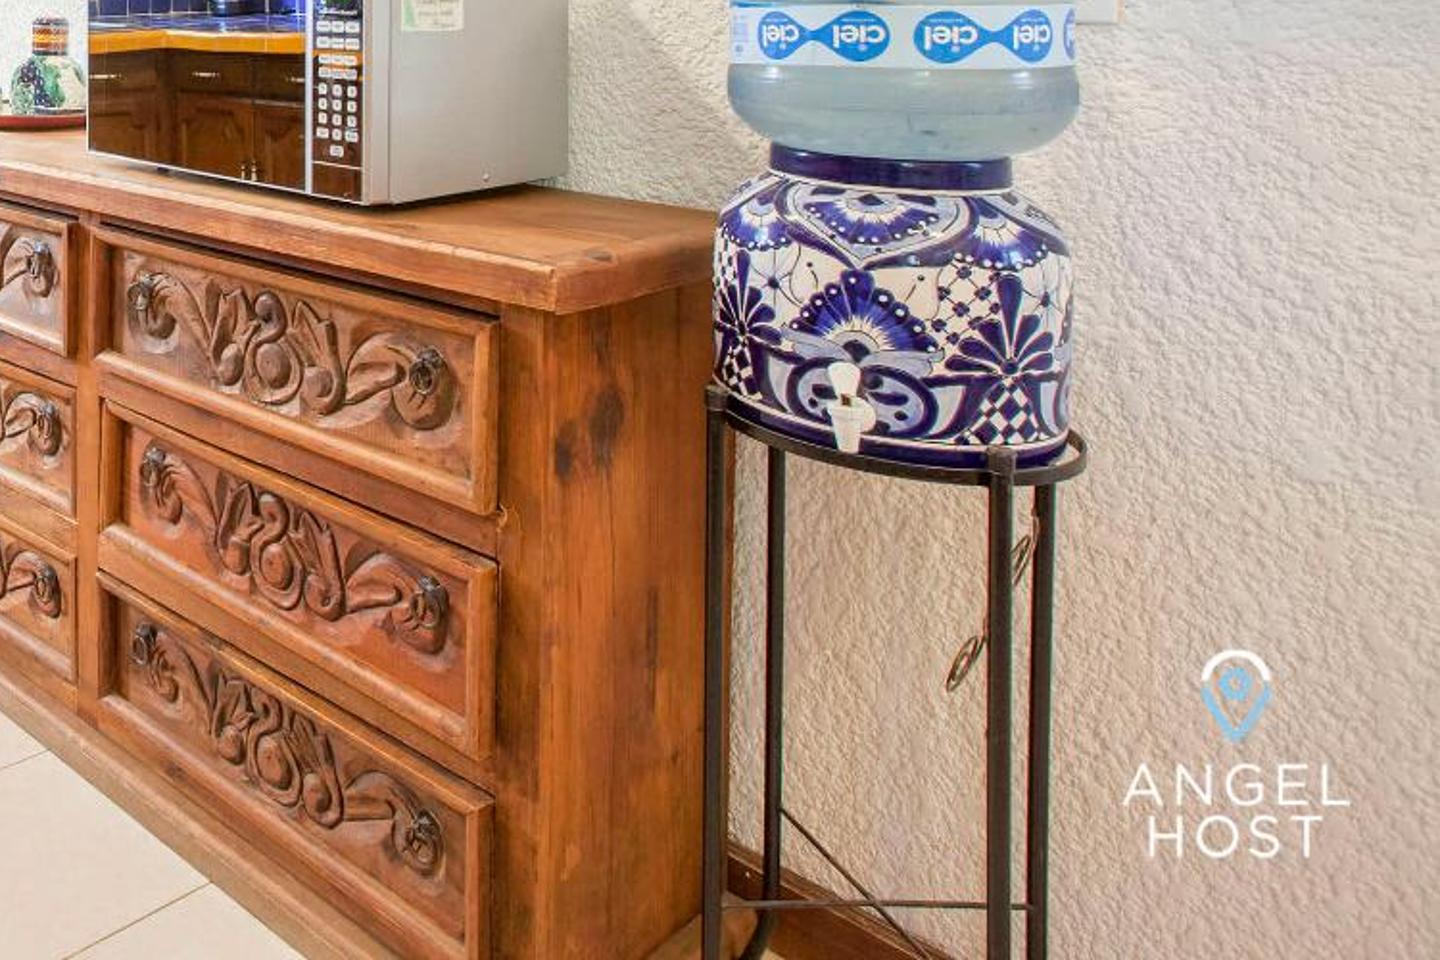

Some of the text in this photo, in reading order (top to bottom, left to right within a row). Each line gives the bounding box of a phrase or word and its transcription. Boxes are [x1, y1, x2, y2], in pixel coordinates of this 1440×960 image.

[762, 24, 800, 50] ciel
[832, 24, 886, 52] ciel
[923, 24, 979, 53] ciel
[1013, 24, 1051, 52] ciel
